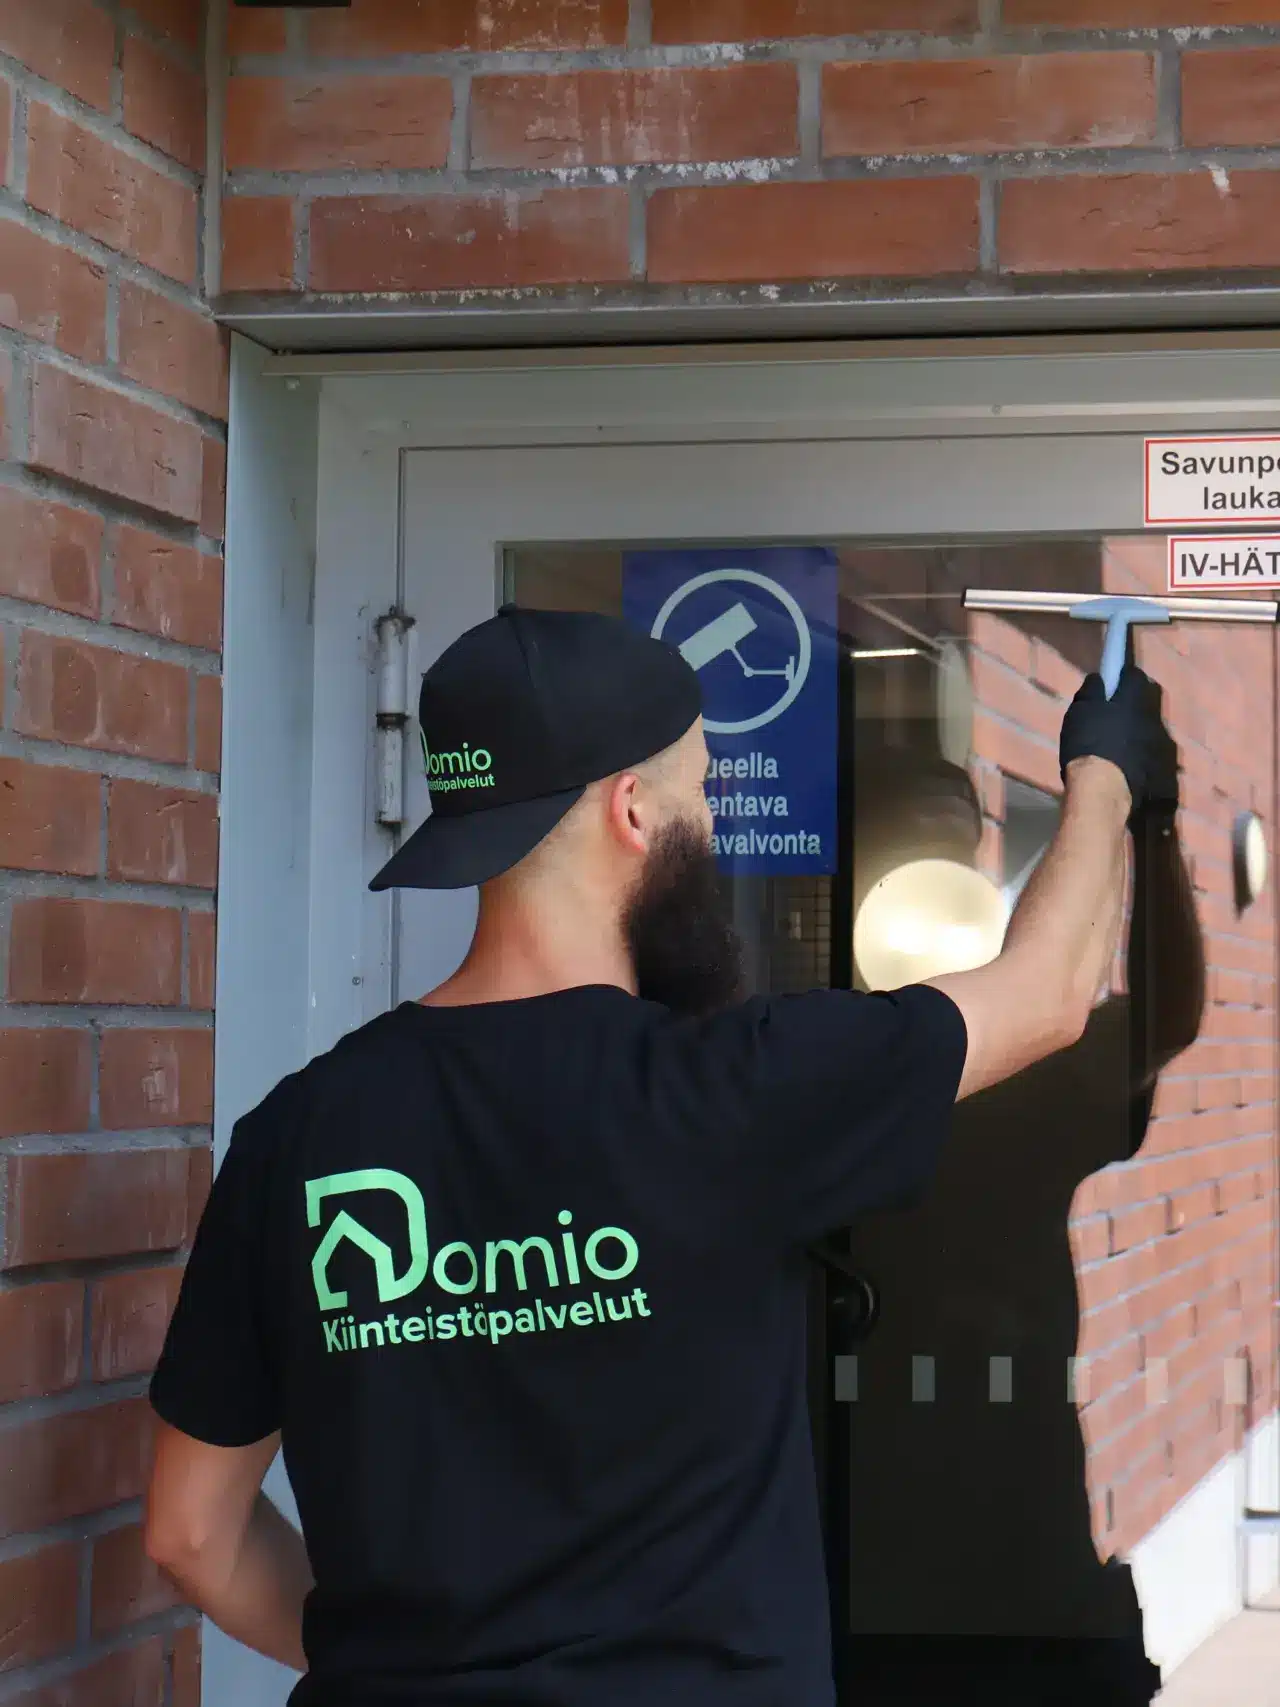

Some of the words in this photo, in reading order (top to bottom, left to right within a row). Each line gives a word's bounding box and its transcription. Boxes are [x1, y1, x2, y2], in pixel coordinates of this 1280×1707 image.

[707, 752, 779, 779] ueella
[705, 791, 789, 817] entava
[708, 828, 821, 855] avalvonta
[305, 1168, 639, 1311] Domio
[322, 1287, 652, 1353] Kiinteistöpalvelut
